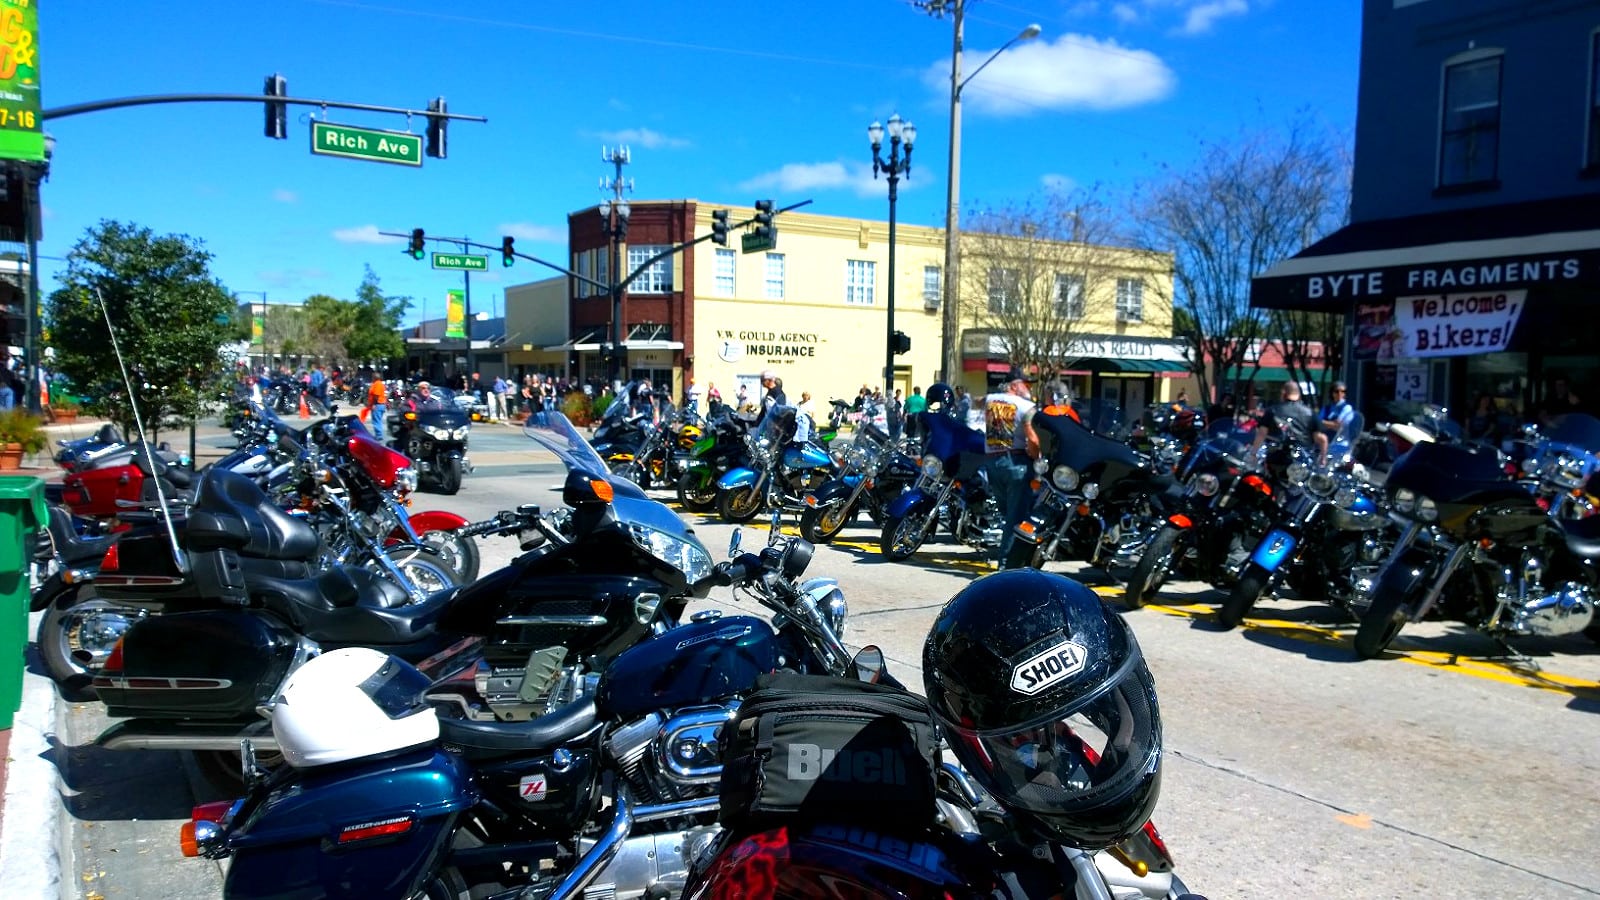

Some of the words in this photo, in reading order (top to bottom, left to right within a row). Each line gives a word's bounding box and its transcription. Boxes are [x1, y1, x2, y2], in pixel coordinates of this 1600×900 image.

[13, 30, 35, 67] &
[326, 131, 368, 150] Rich
[377, 138, 409, 155] Ave
[439, 256, 461, 265] Rich
[465, 257, 482, 267] Ave
[1308, 272, 1383, 298] BYTE
[1408, 259, 1580, 289] FRAGMENTS
[1412, 293, 1518, 320] Welcome,
[739, 331, 775, 341] GOULD
[779, 333, 819, 343] AGENCY
[1416, 321, 1512, 351] Bikers!
[746, 345, 815, 357] INSURANCE
[1020, 647, 1079, 689] SHOEI
[787, 743, 907, 786] Buell
